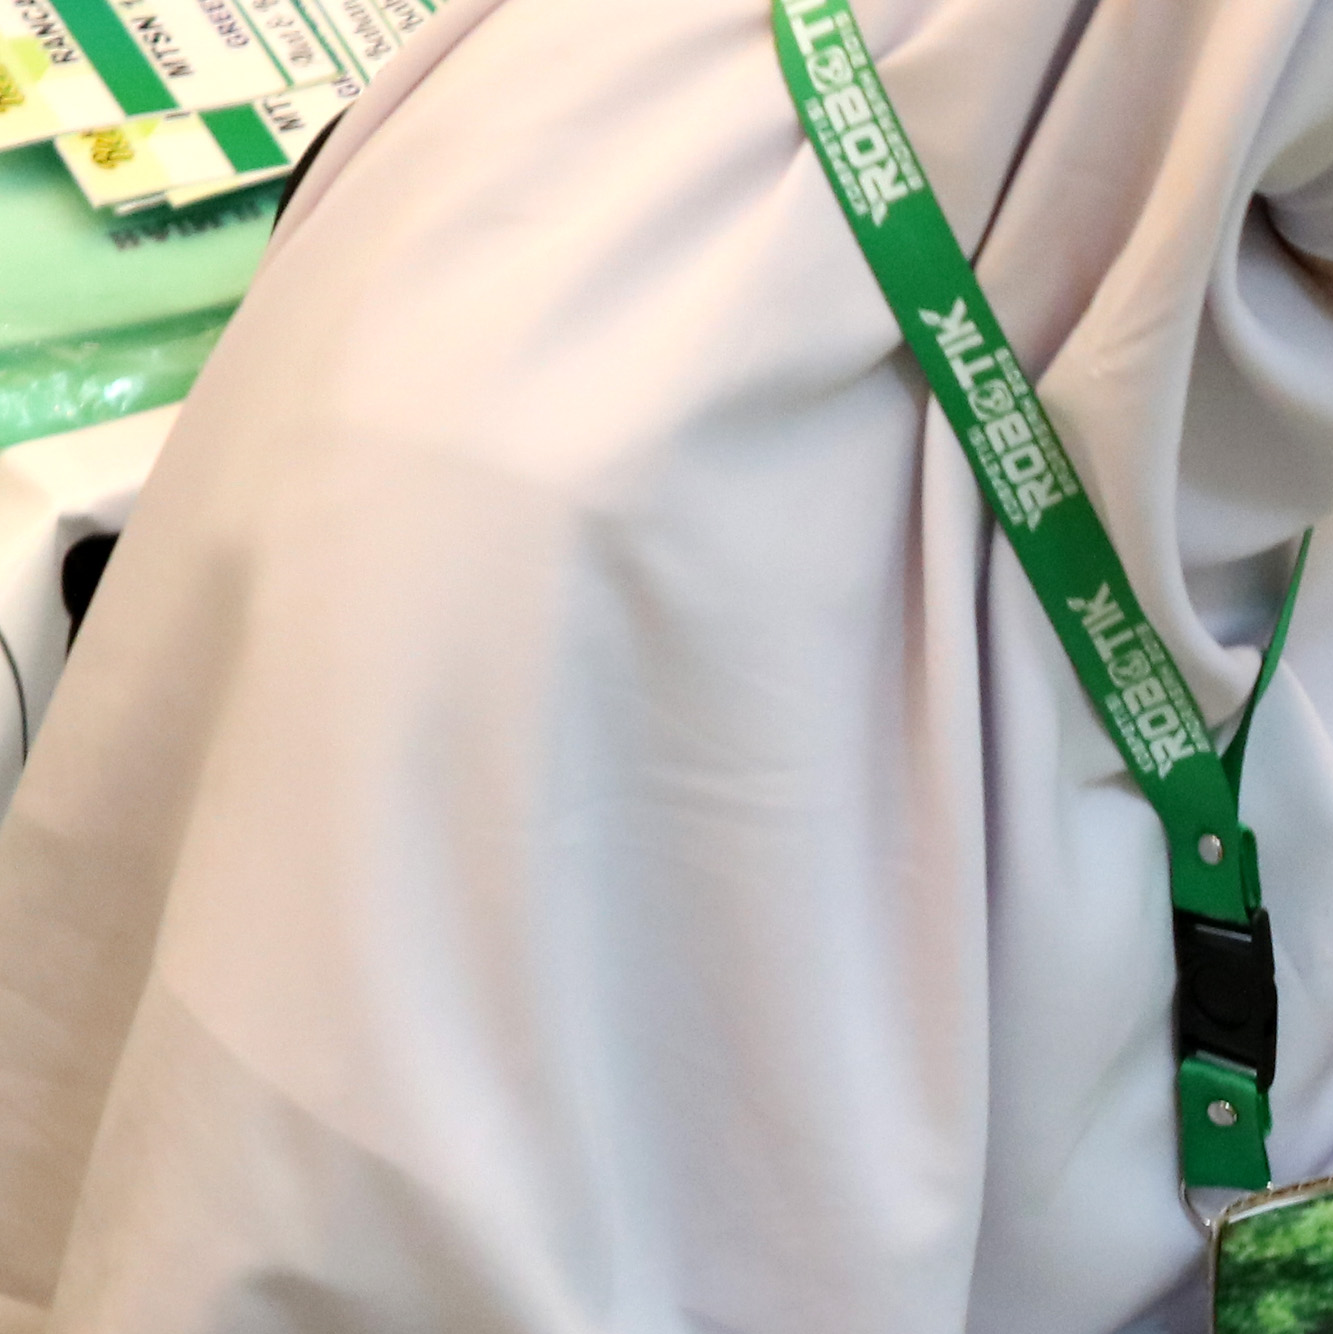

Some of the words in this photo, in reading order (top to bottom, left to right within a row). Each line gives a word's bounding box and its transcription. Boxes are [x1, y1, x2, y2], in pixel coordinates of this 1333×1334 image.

[131, 15, 196, 78] MTSN
[918, 297, 1063, 532] ROBOTIK
[1066, 582, 1196, 780] ROBOTIK
